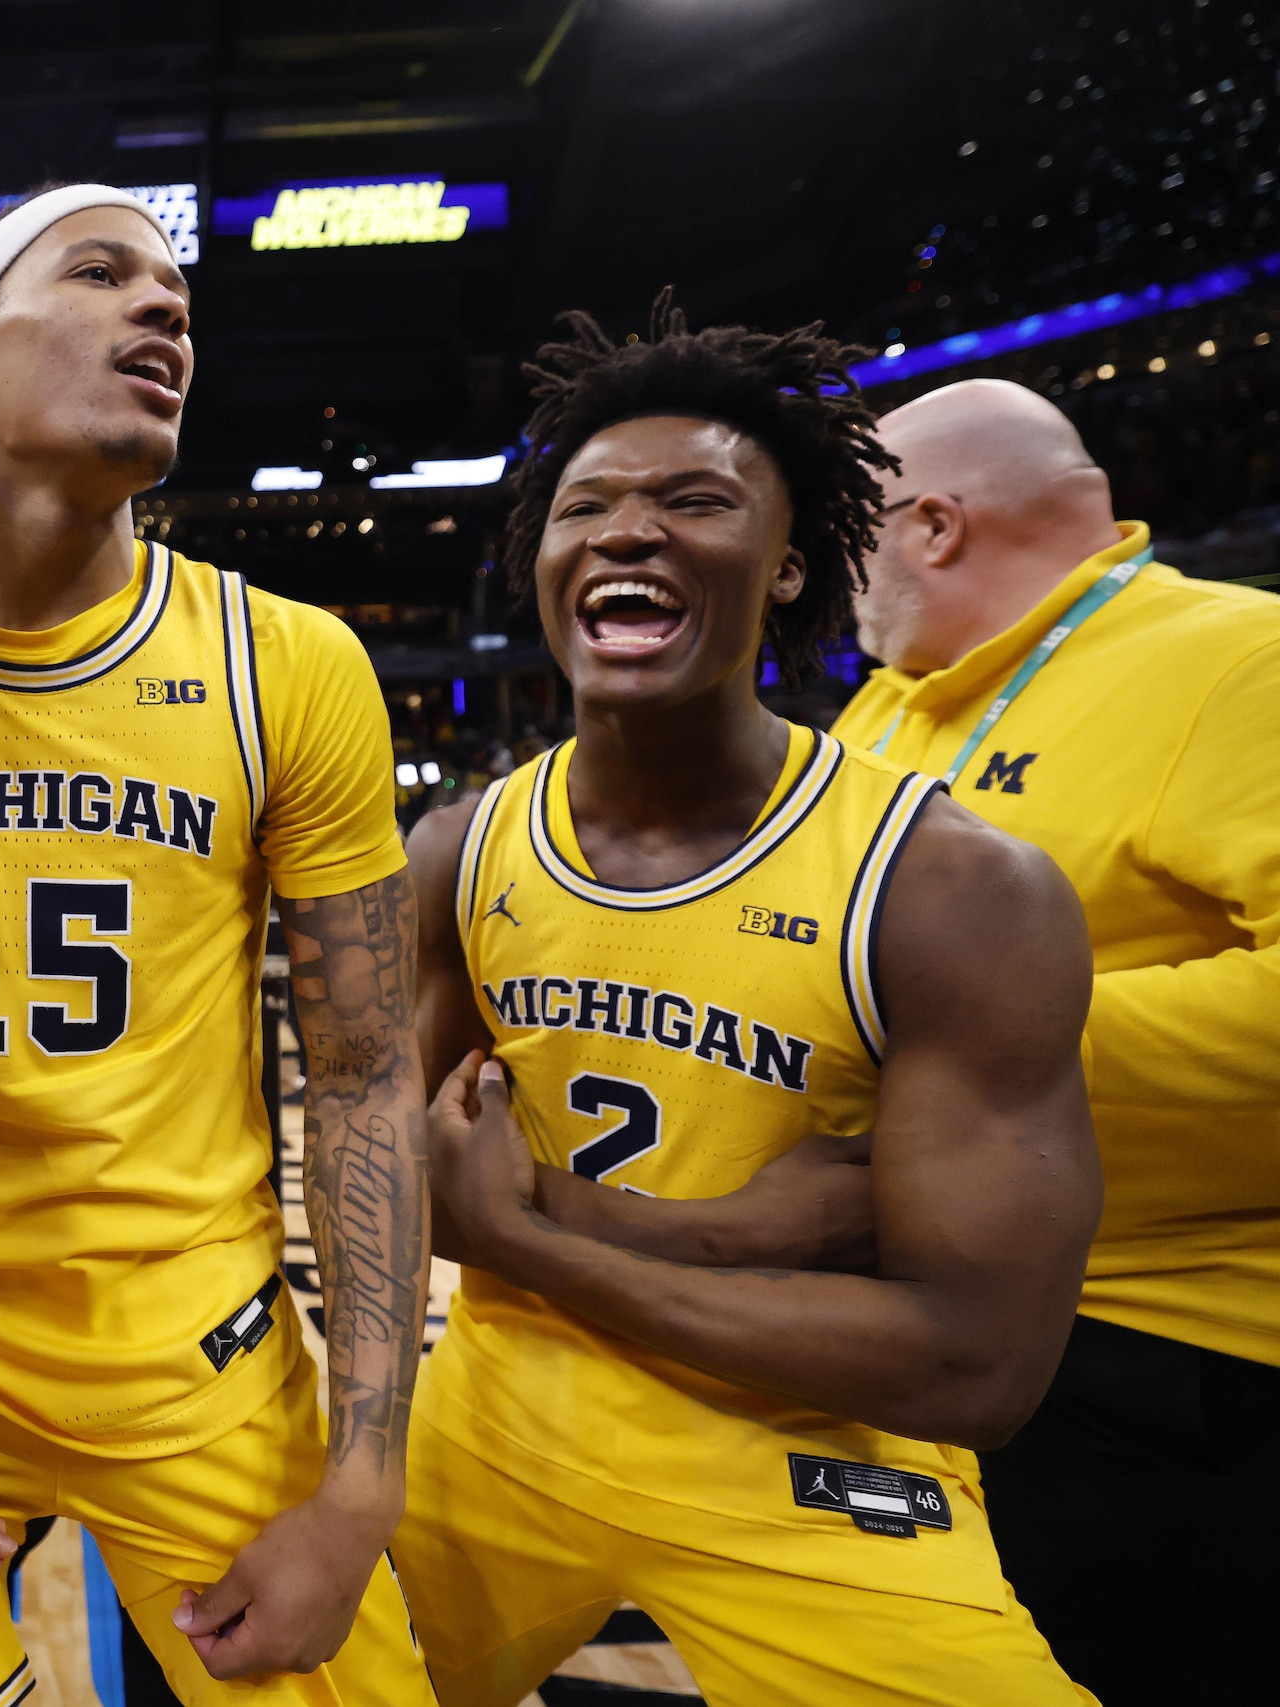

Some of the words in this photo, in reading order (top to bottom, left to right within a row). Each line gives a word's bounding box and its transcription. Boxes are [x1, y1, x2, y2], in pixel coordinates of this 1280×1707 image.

[975, 752, 1040, 794] M
[480, 973, 815, 1093] MICHIGAN
[566, 1070, 663, 1199] 2
[915, 1489, 941, 1512] 46
